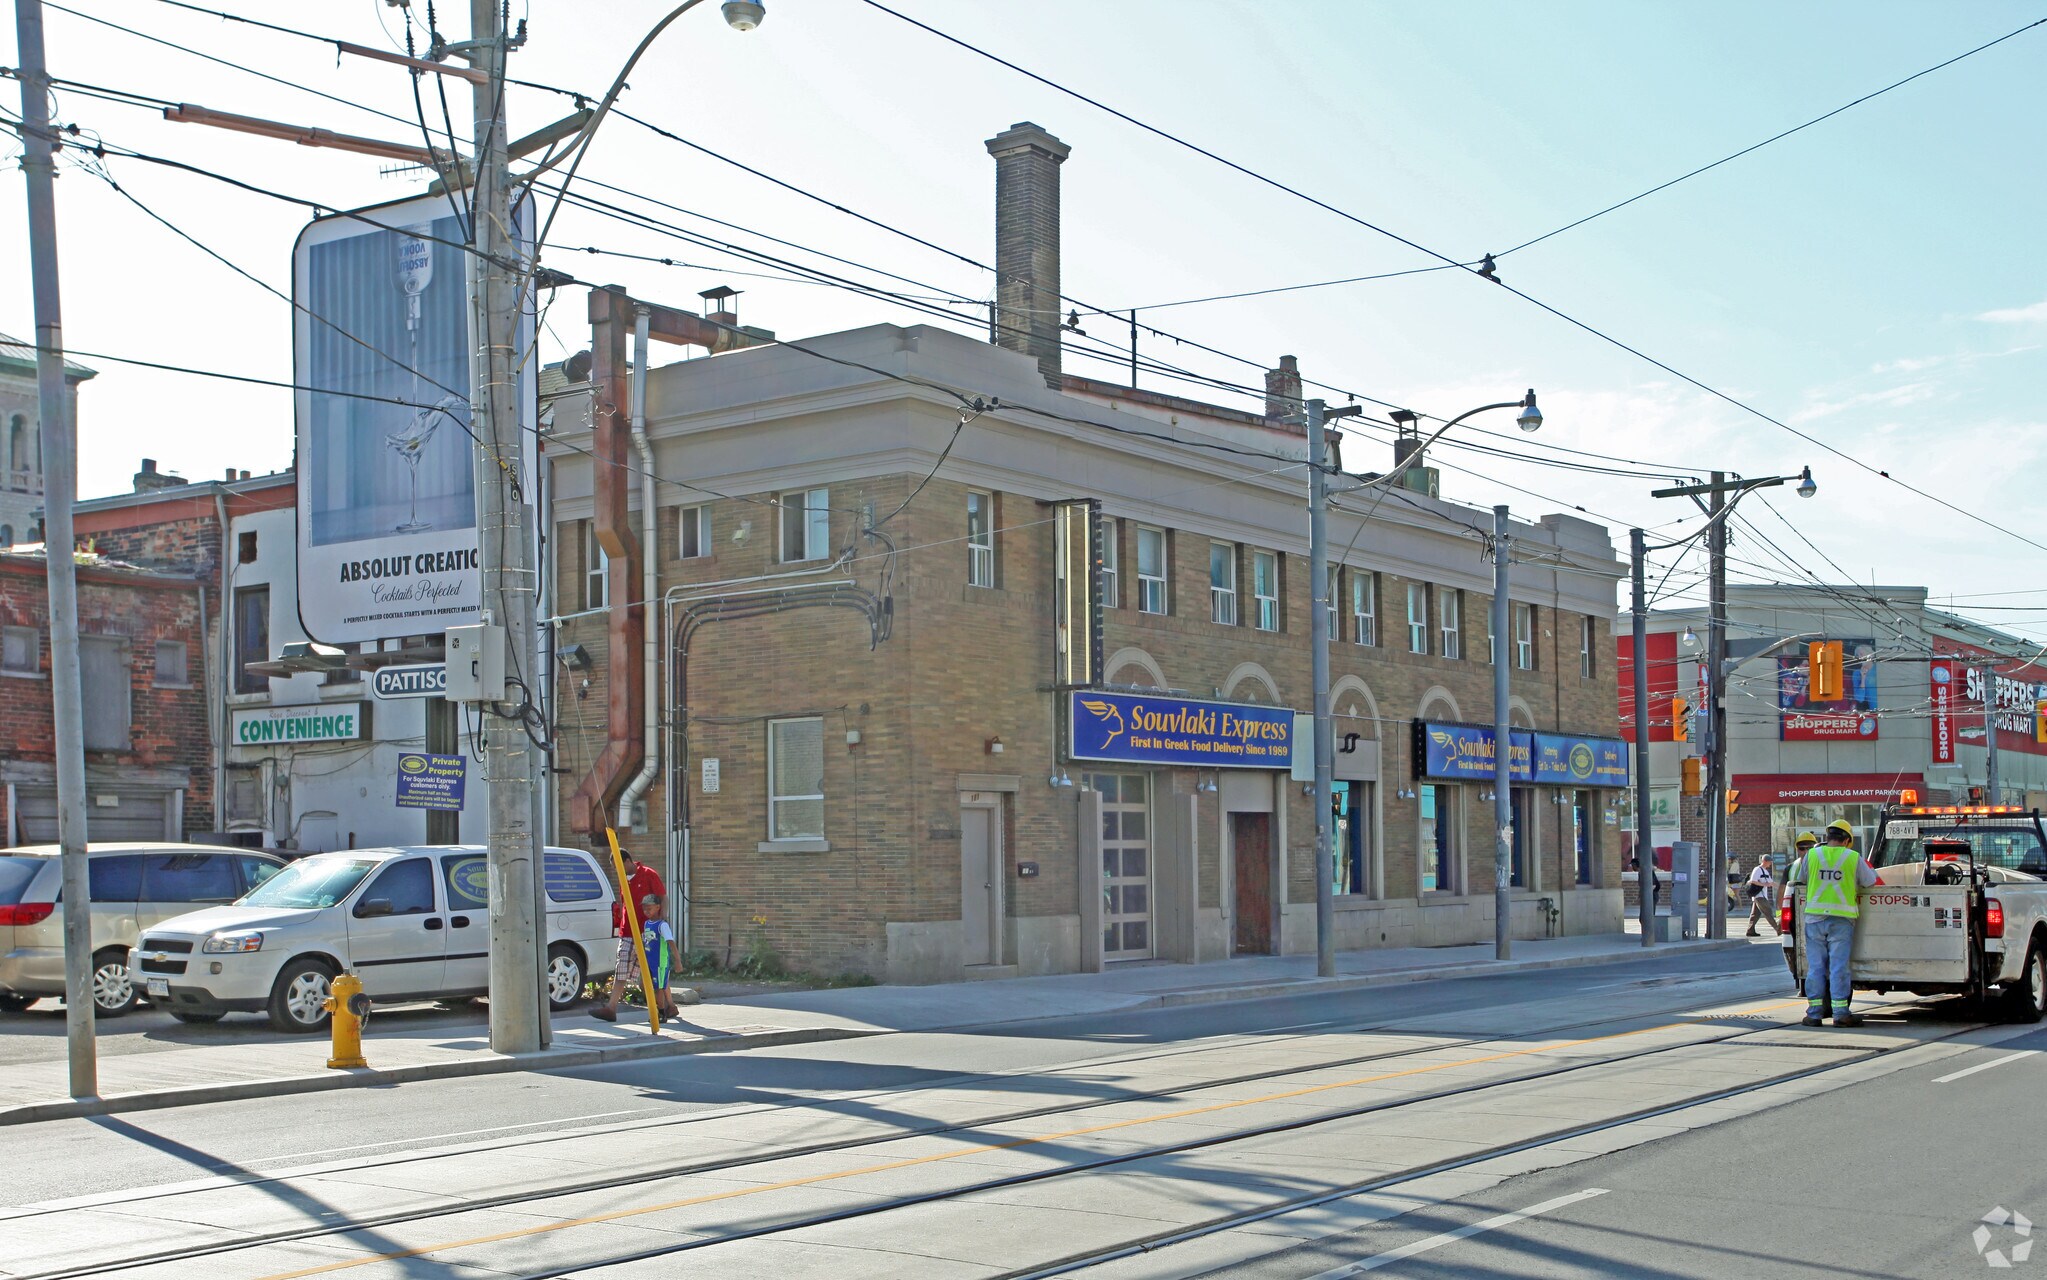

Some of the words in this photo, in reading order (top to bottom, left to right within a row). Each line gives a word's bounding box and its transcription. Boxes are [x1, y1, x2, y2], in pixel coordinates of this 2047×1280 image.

[340, 555, 412, 583] ABSOLUT
[415, 548, 479, 575] CREATIO
[371, 582, 414, 604] Cocktails
[415, 579, 463, 604] Perfected
[383, 611, 404, 620] COCKTAIL
[437, 606, 461, 615] PERFECTLY
[381, 670, 446, 691] PATTISO
[1966, 667, 2035, 712] SHPPERS
[240, 714, 353, 743] CONVENIENCE
[1131, 705, 1216, 735] Souvlaki
[1221, 713, 1287, 744] Express
[1786, 719, 1858, 729] SHOPPERS
[2013, 715, 2032, 735] MART
[1131, 735, 1151, 748] First
[1153, 737, 1163, 749] In
[1164, 738, 1190, 751] Greek
[1191, 740, 1211, 752] Food
[1213, 741, 1244, 756] Delivery
[1246, 743, 1266, 755] Since
[1268, 745, 1288, 757] 1989
[1458, 736, 1495, 759] Souvlaki
[1508, 746, 1529, 761] press
[432, 757, 461, 766] Private
[413, 776, 436, 784] Souvlaki
[436, 777, 457, 785] Express
[428, 767, 464, 778] Property
[1778, 789, 1826, 798] SHOPPERS
[1828, 789, 1851, 797] DRUG
[1819, 869, 1842, 881] TTC
[1869, 895, 1910, 906] STOPS
